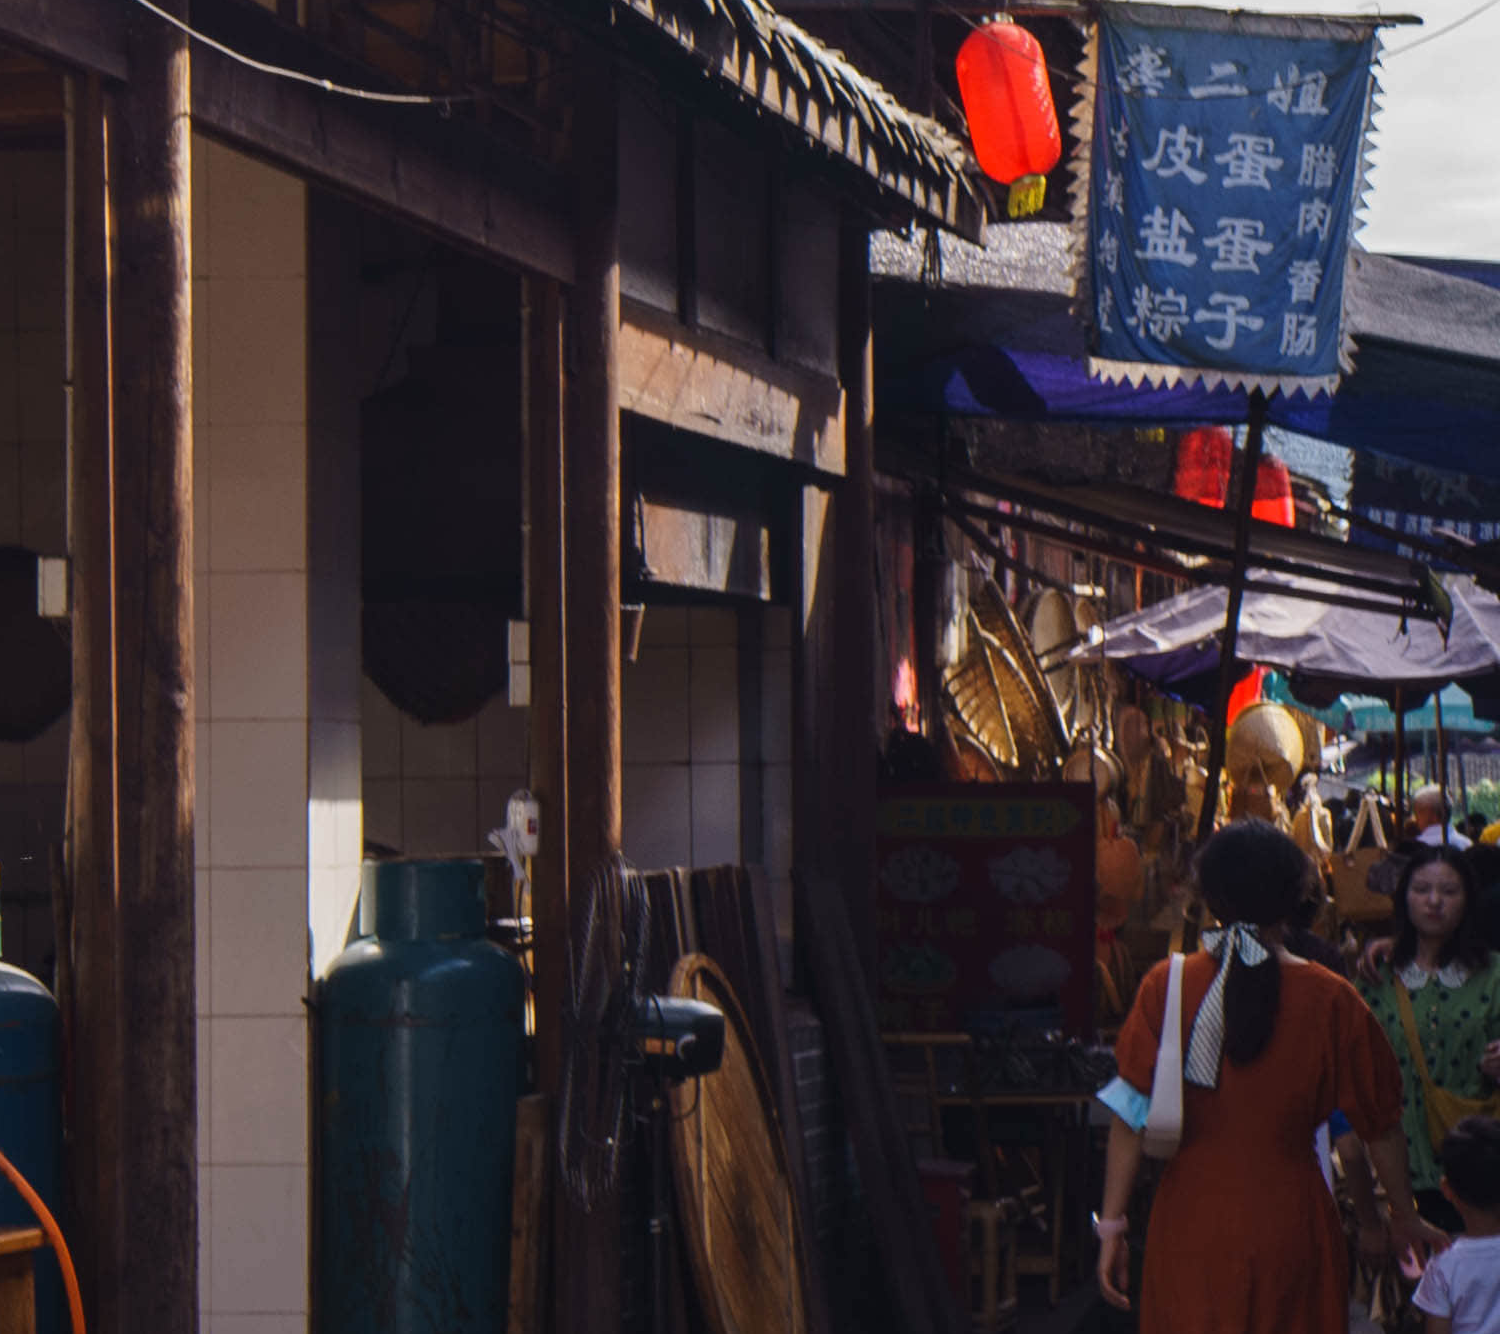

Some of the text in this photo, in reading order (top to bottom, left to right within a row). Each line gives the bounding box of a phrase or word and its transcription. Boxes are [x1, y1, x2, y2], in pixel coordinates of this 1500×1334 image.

[1141, 123, 1284, 191] 皮蛋
[1134, 205, 1275, 275] 盐蛋
[1125, 283, 1265, 352] 粽子
